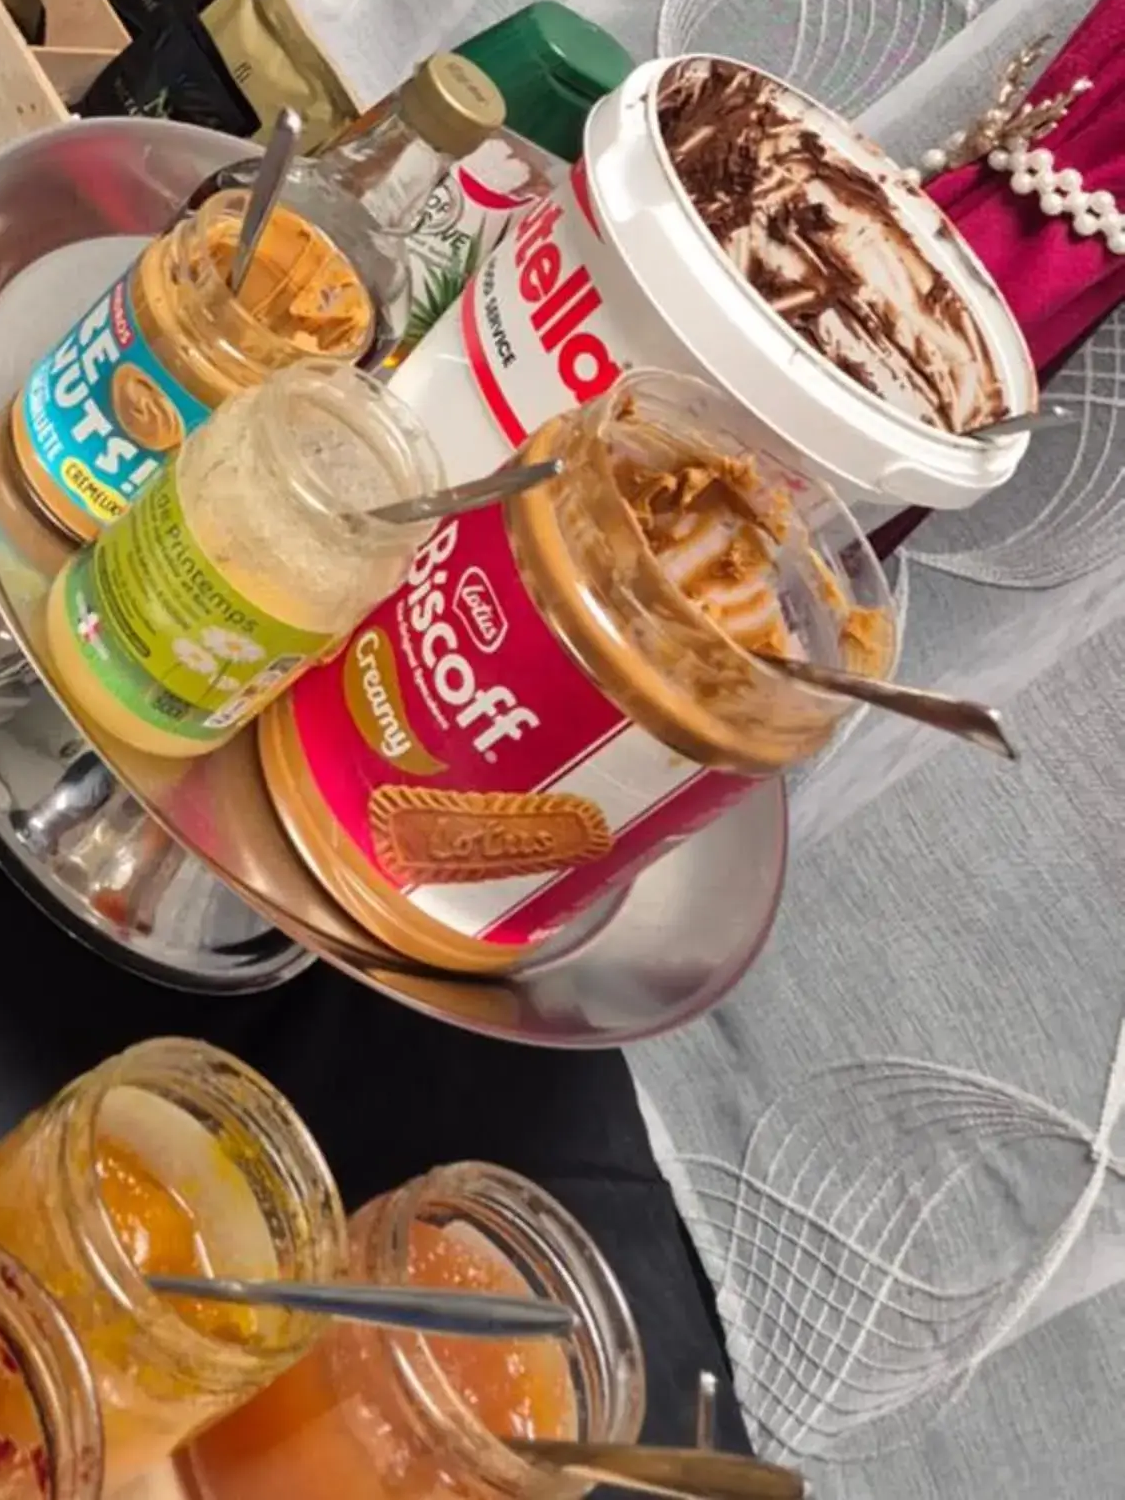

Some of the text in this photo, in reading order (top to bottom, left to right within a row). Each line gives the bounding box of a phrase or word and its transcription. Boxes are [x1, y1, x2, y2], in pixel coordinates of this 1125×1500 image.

[482, 297, 517, 368] SERVICE
[51, 332, 159, 495] NUTS!
[165, 522, 259, 634] Printemps
[407, 519, 541, 752] Biscoff
[356, 630, 413, 758] Creamy
